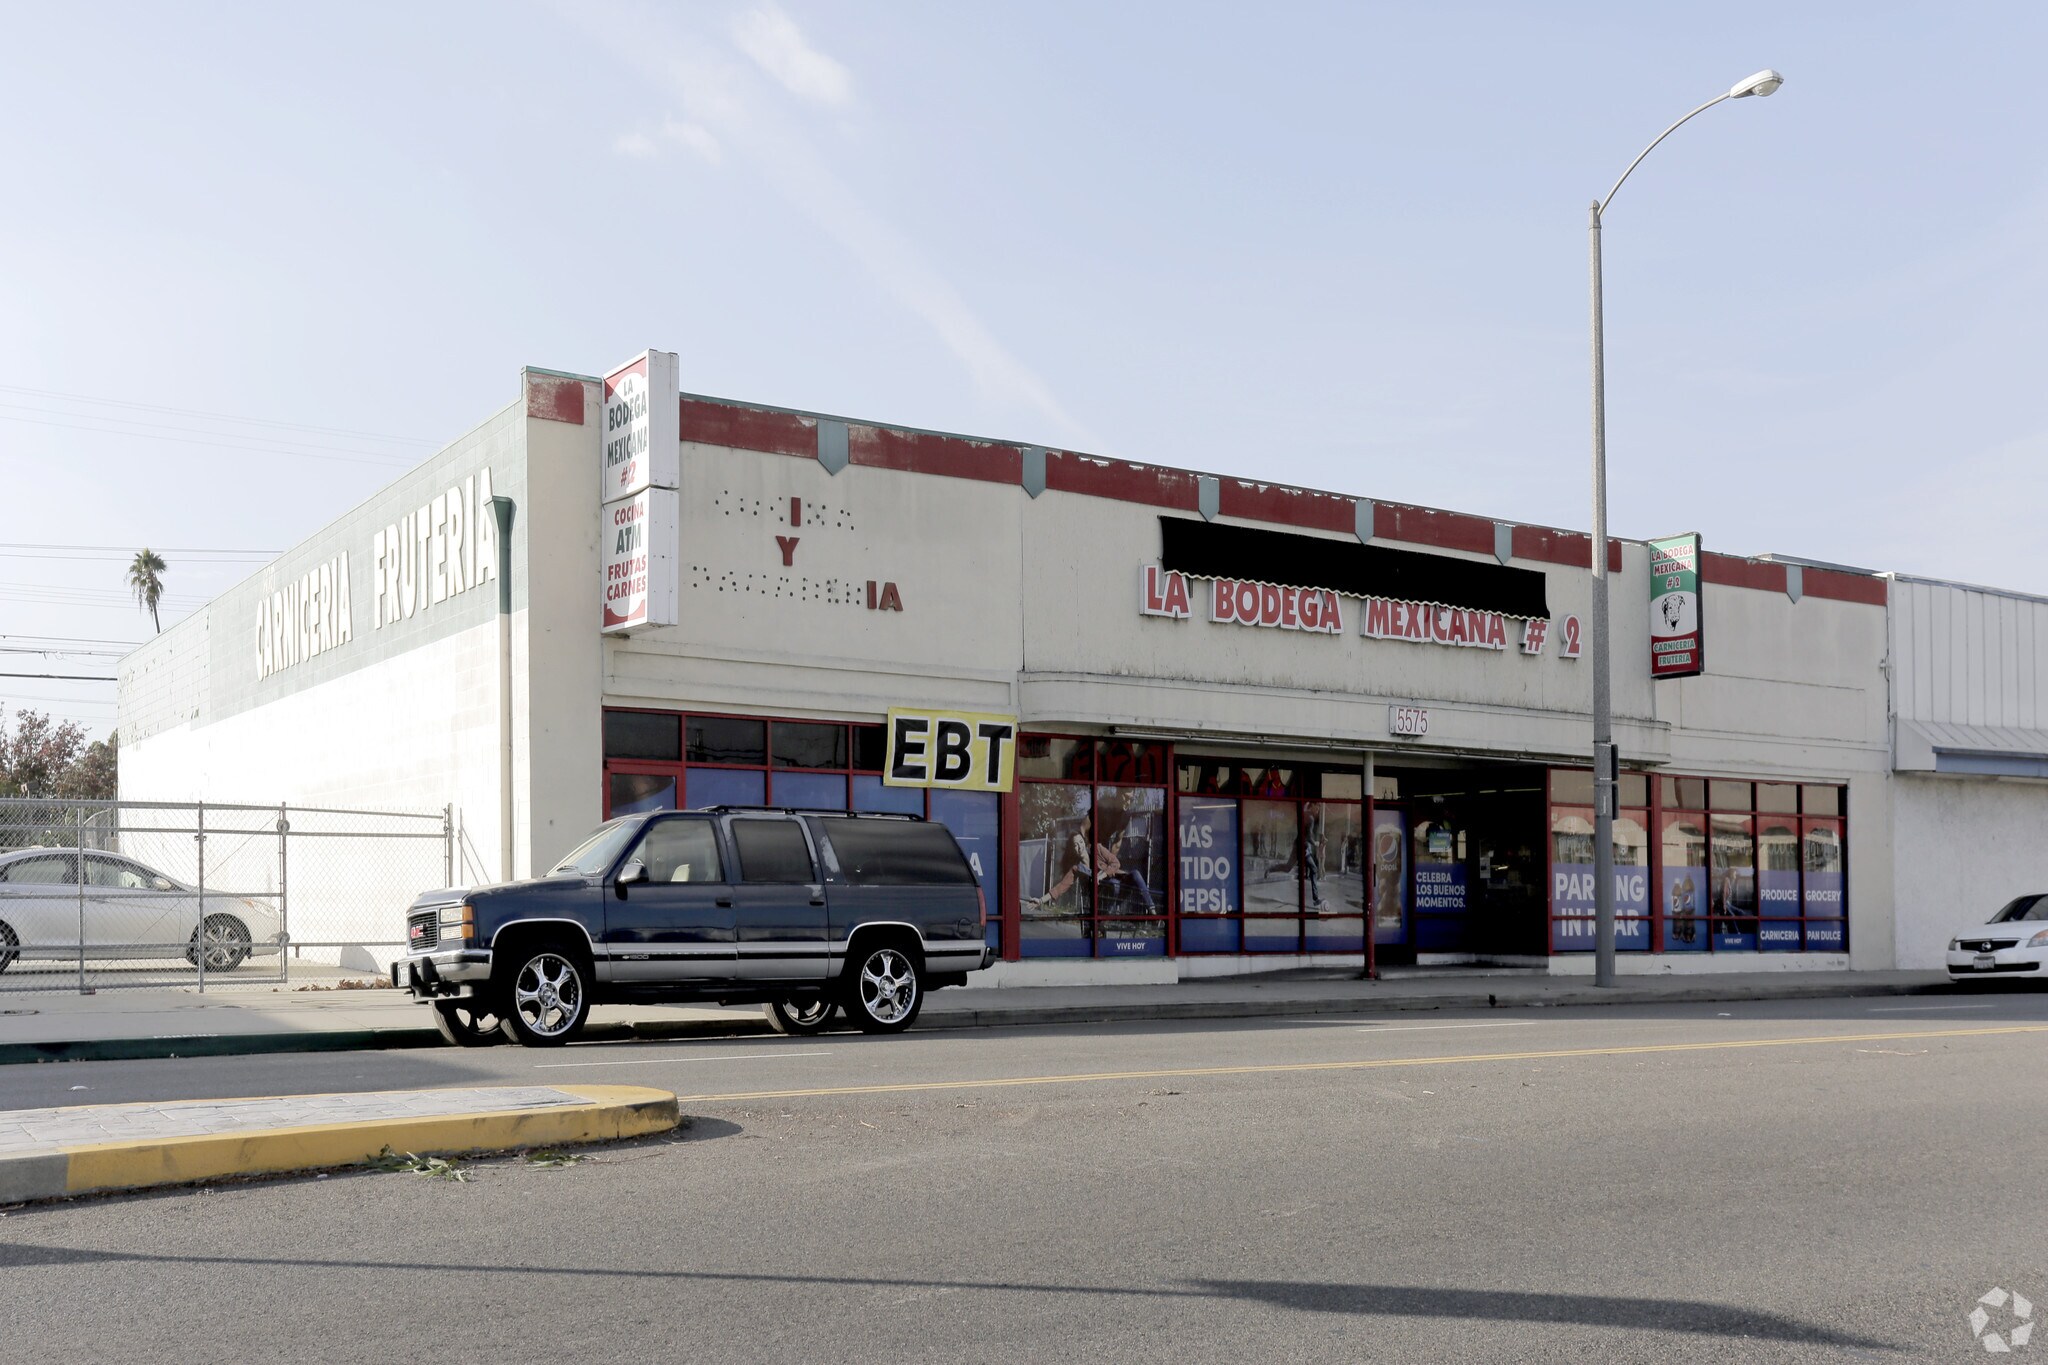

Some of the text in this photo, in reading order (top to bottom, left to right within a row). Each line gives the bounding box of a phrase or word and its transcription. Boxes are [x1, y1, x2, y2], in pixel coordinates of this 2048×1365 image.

[624, 378, 633, 396] LA
[609, 390, 647, 432] BODEGA
[607, 426, 647, 468] MEXICANA
[614, 501, 644, 526] COCINA
[616, 523, 641, 555] ATM
[775, 535, 800, 567] Y
[1653, 544, 1694, 561] LA BODEGA
[256, 466, 496, 682] CARNICERIA FRUTERIA
[608, 554, 646, 581] FRUTAS
[1653, 560, 1693, 576] MEXICANA
[607, 575, 646, 602] CARNES
[1142, 565, 1192, 618] LA
[1212, 578, 1344, 633] BODEGA
[1365, 598, 1508, 649] MEXICANA
[1565, 615, 1582, 657] 2
[1653, 638, 1696, 654] CARNICERIA
[1658, 653, 1692, 667] FRUTERIA
[1397, 708, 1428, 734] 5575
[891, 716, 1013, 785] EBT
[1416, 872, 1452, 883] CELEBRA
[1555, 873, 1645, 902] PARNG
[1180, 888, 1232, 912] EPSI.
[1416, 885, 1466, 896] LOS BUENOS
[1416, 897, 1466, 908] MOMENTOS.
[1760, 889, 1798, 901] PRODUCE
[1805, 890, 1842, 902] GROCERY
[1562, 907, 1582, 936] IN
[1116, 942, 1145, 950] VIVE HOY
[1760, 930, 1800, 941] CARNICERIA
[1807, 930, 1842, 941] PAN DULCE
